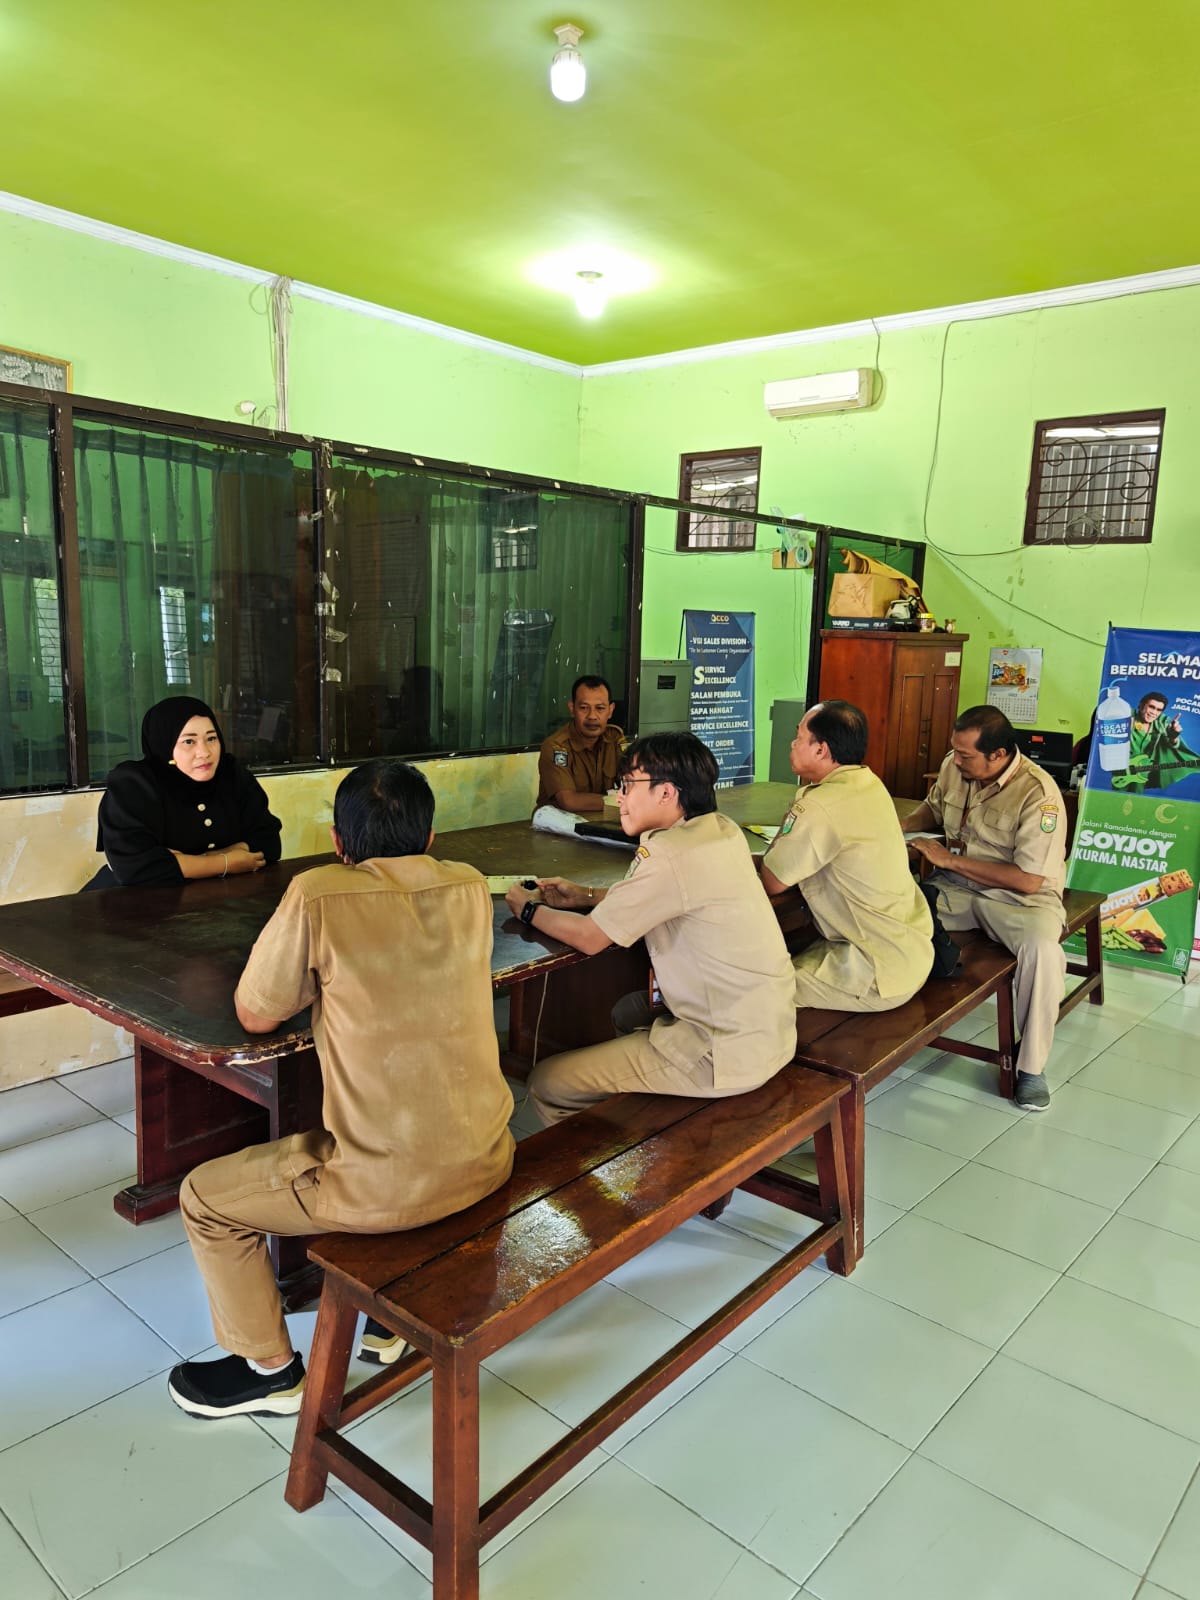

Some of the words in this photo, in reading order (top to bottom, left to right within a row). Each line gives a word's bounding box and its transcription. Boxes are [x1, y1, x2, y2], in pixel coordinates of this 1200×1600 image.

[703, 637, 720, 645] SALES
[1110, 664, 1178, 677] BERBUKA
[1182, 668, 1200, 680] PU
[1170, 703, 1191, 712] JAGA
[1081, 819, 1102, 828] Jalani
[1103, 822, 1148, 835] Ramadanmu
[1149, 828, 1177, 840] dengan
[1078, 829, 1174, 859] SOYJOY
[1075, 847, 1117, 866] KURMA
[1121, 855, 1168, 873] NASTAR
[1100, 895, 1134, 913] OYJOY
